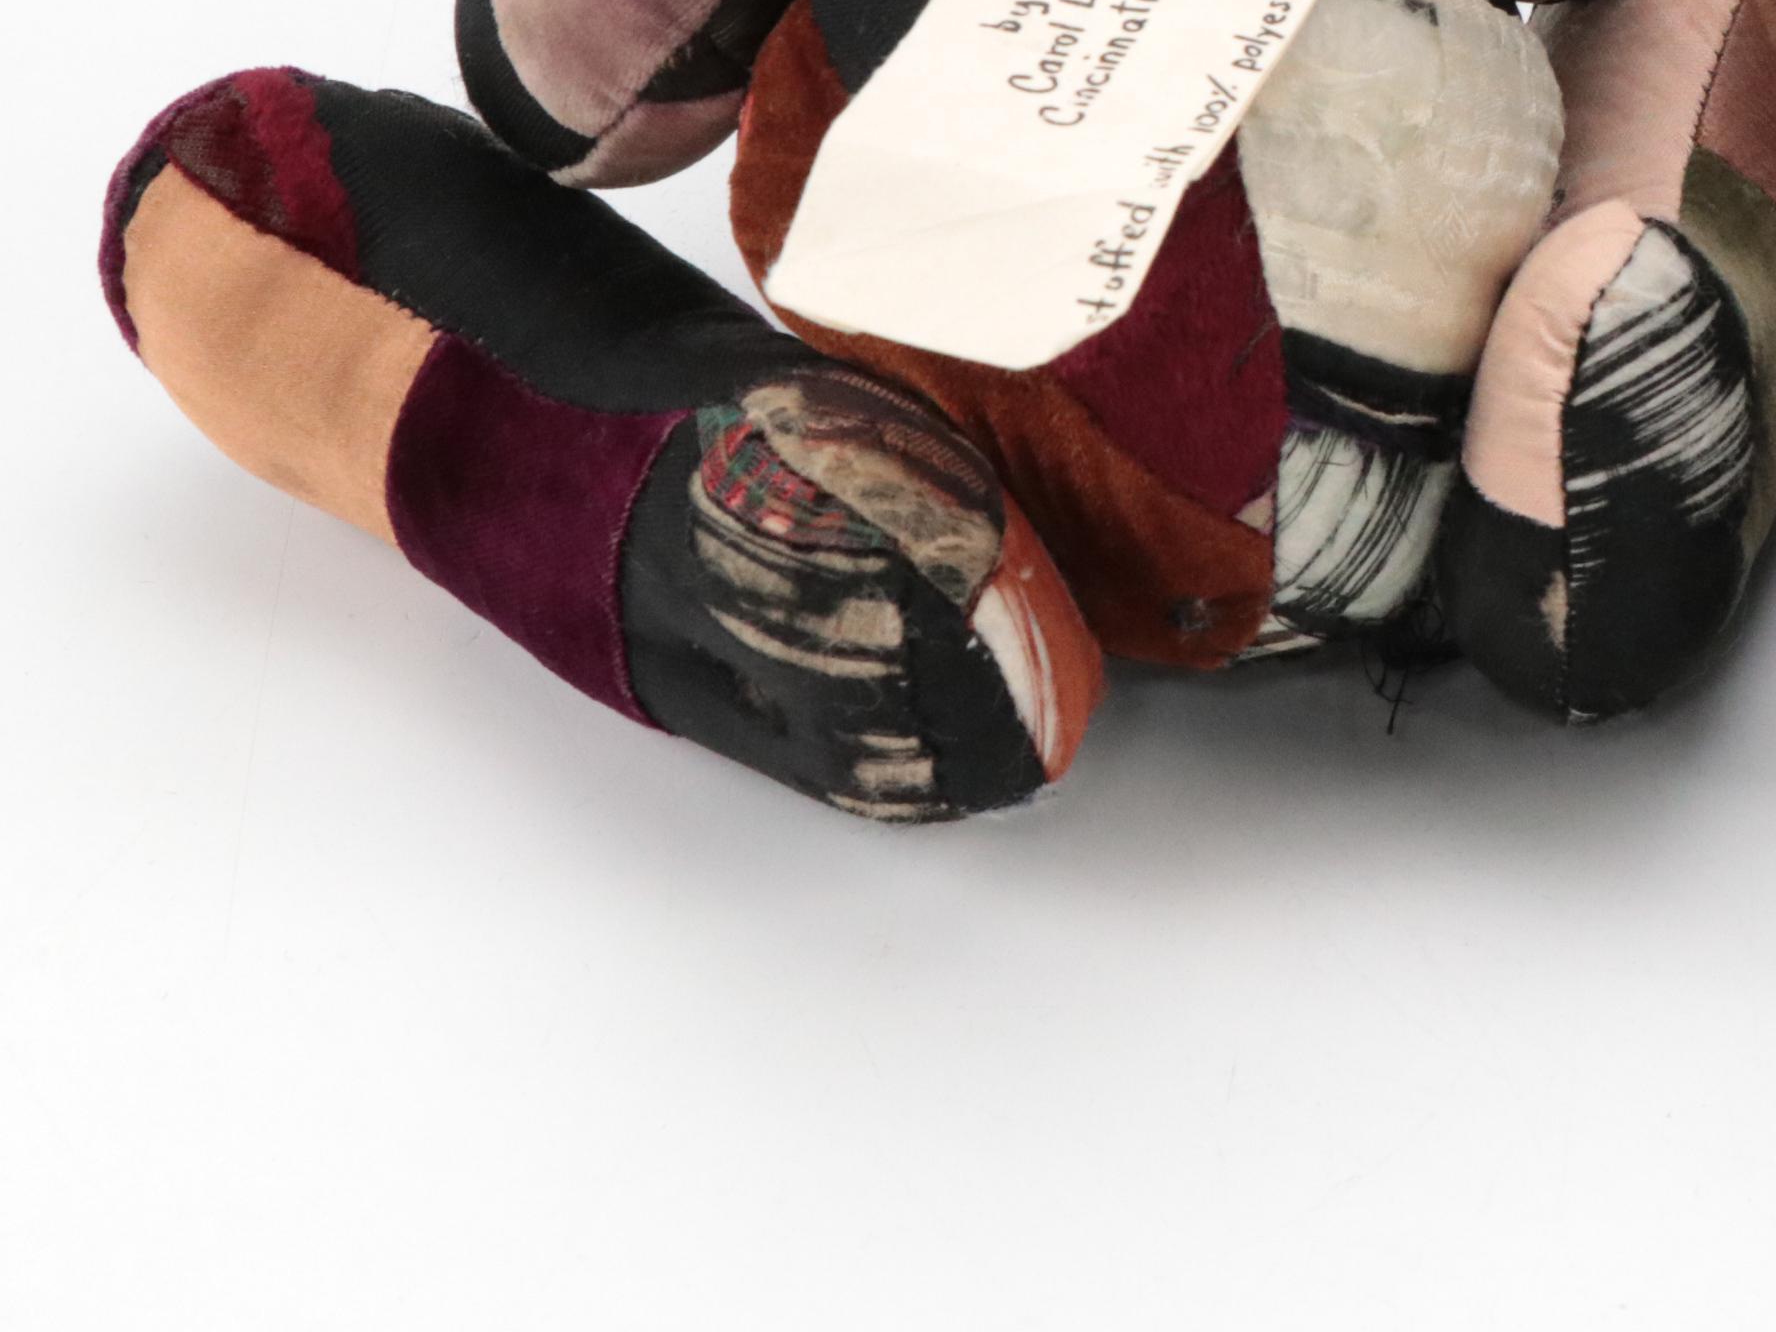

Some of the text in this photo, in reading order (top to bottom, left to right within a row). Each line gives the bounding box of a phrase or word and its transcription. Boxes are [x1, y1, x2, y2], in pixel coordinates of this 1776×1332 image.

[979, 0, 1050, 33] by
[1007, 21, 1085, 94] Carol
[1144, 145, 1195, 189] with
[1188, 73, 1239, 134] 100%
